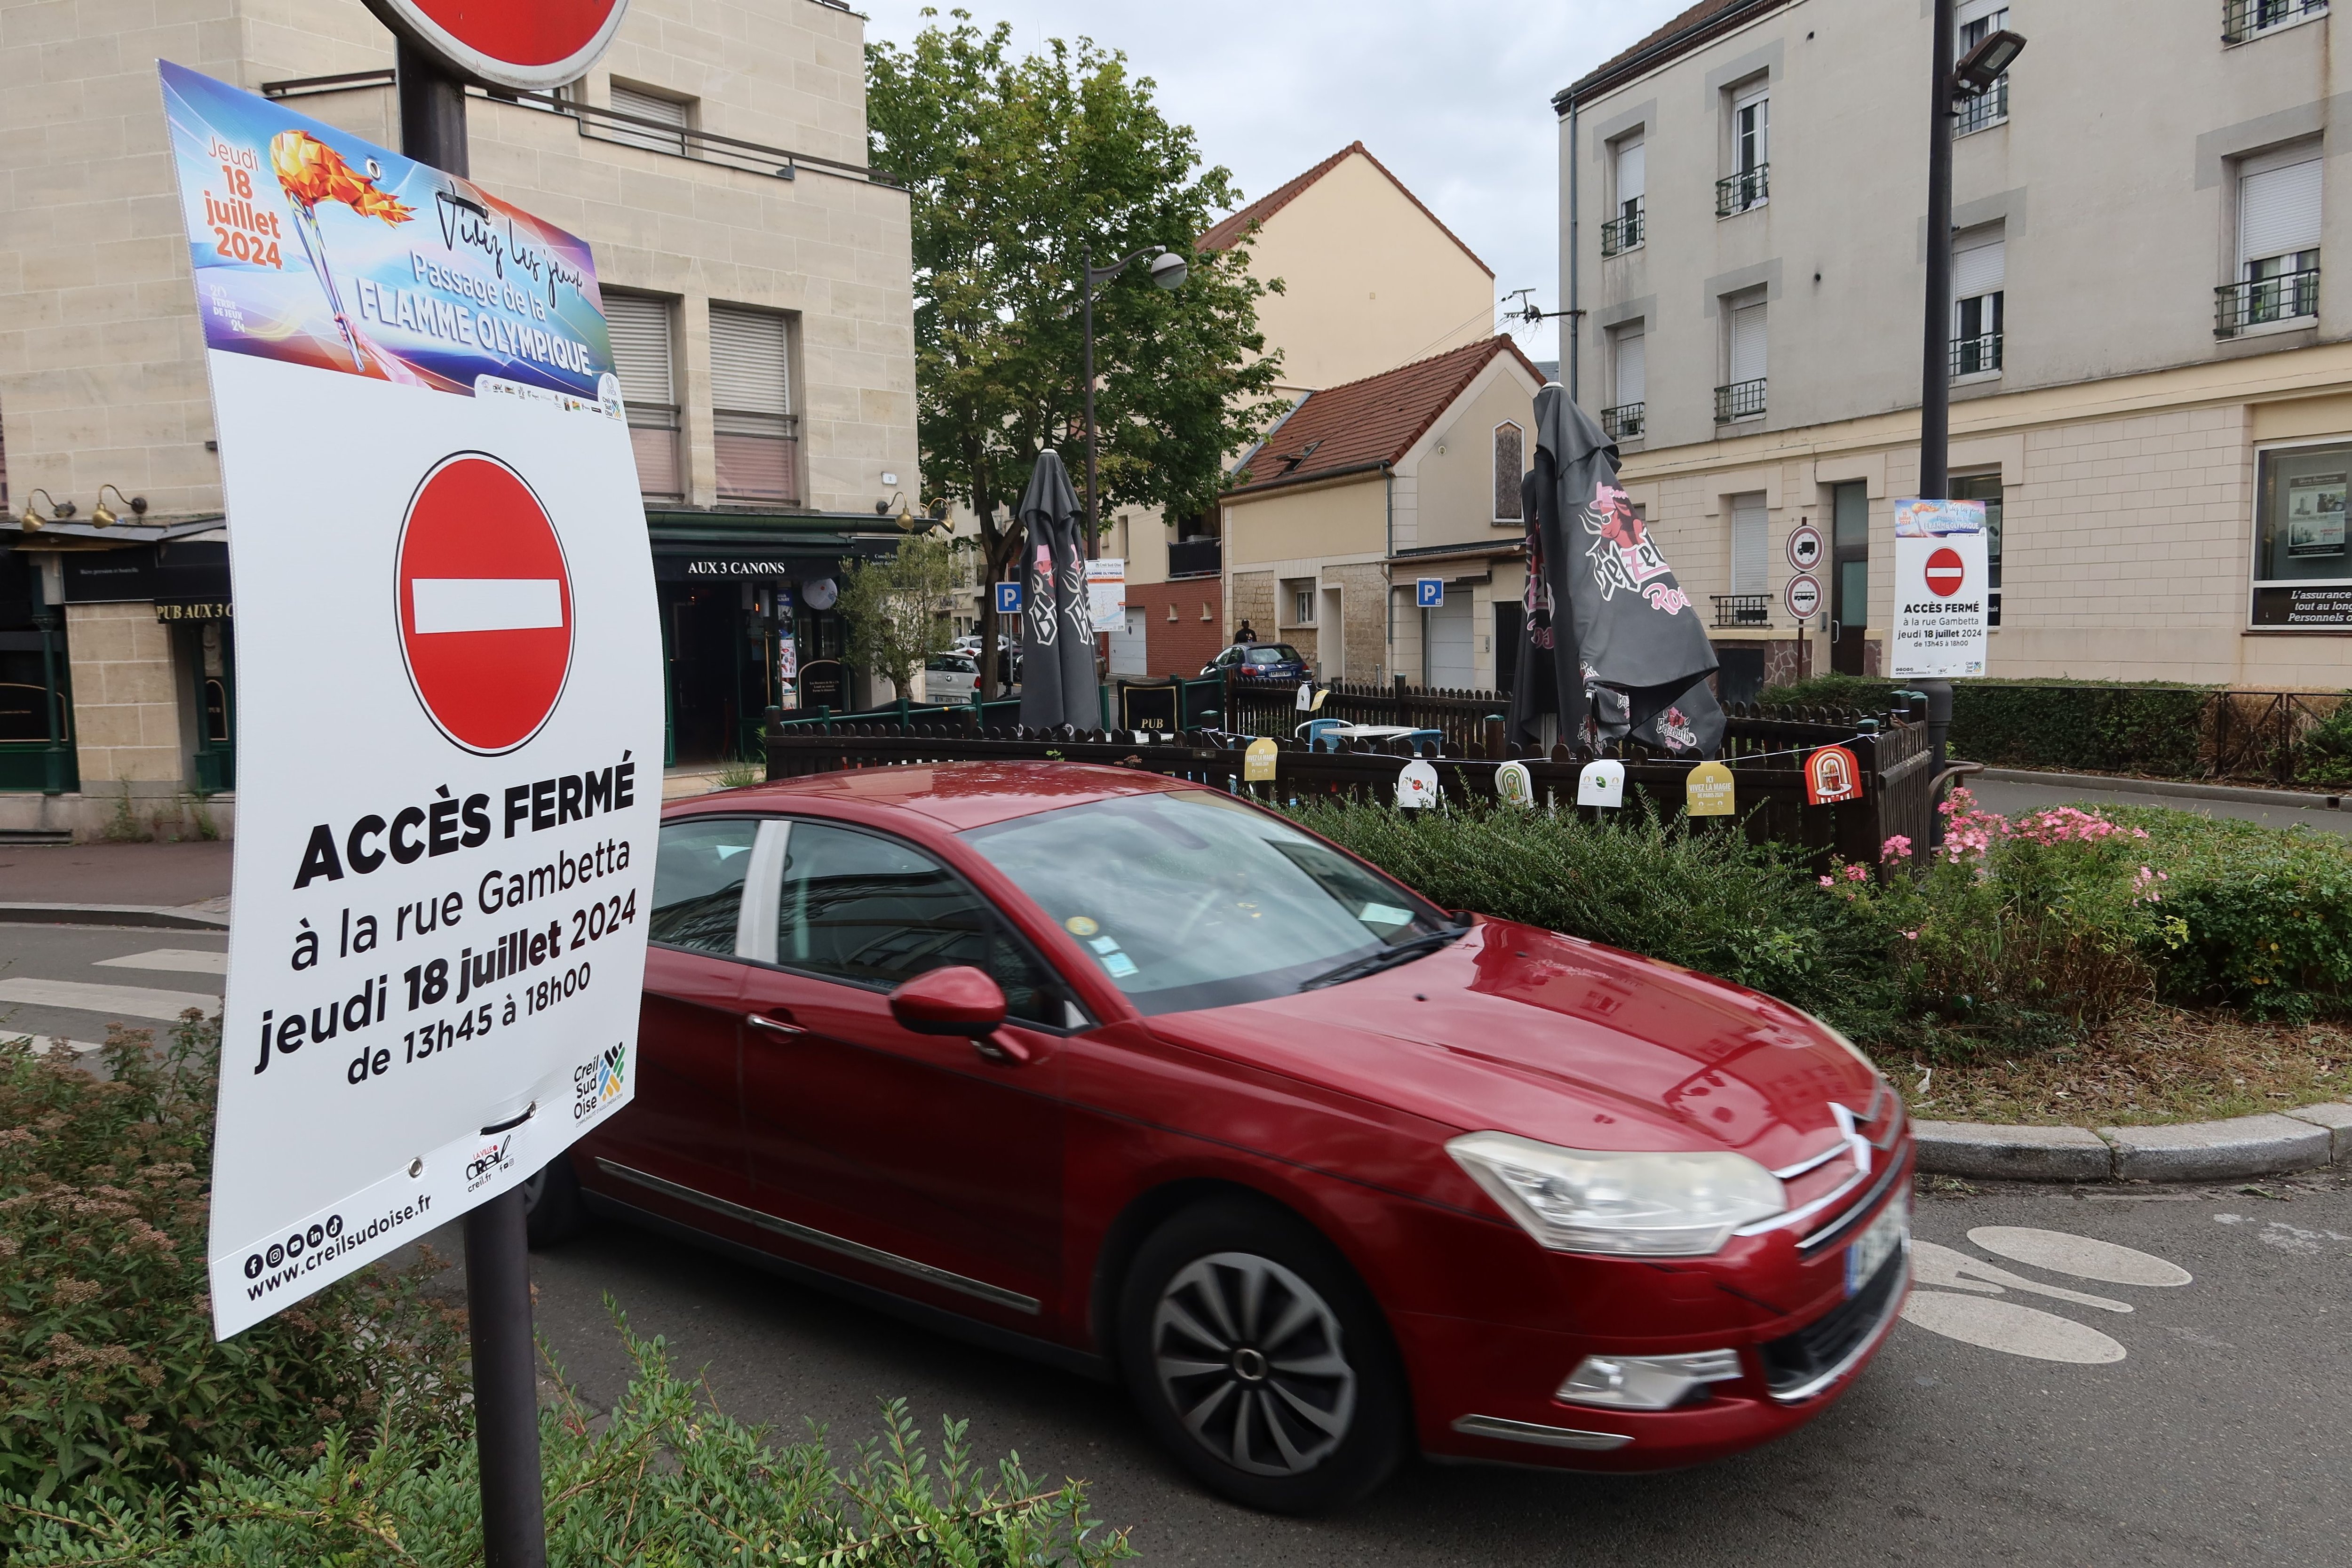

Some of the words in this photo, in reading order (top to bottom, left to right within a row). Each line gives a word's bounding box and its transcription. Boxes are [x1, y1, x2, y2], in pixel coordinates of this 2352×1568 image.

[208, 136, 259, 172] Jeudi
[222, 165, 253, 199] 18
[204, 190, 281, 239] juillet
[214, 227, 283, 270] 2024
[411, 249, 499, 307] Passage
[503, 281, 525, 310] de
[528, 289, 546, 322] la
[212, 297, 237, 310] TERRE
[213, 306, 224, 317] DE
[224, 309, 244, 321] JEUX
[231, 319, 245, 333] 24
[357, 278, 472, 344] FLAMME
[476, 312, 593, 377] OLYMPIQUE
[688, 562, 718, 573] AUX
[720, 562, 727, 573] 3
[731, 562, 785, 574] CANONS
[1004, 589, 1016, 606] P
[1424, 585, 1436, 601] P
[2290, 590, 2352, 599] L'assurance
[156, 605, 182, 620] PUB
[183, 604, 213, 618] AUX
[215, 603, 223, 617] 3
[1904, 602, 1942, 613] ACCÈS
[1945, 601, 1979, 613] FERMÉ
[2288, 613, 2344, 621] Personnels
[1898, 630, 1921, 640] jeudi
[1935, 629, 1959, 639] juillet
[1141, 718, 1163, 729] PUB
[293, 784, 492, 890] ACCÈS
[504, 749, 636, 839] FERMÉ
[291, 917, 318, 971] à
[340, 908, 377, 958] la
[397, 892, 463, 942] rue
[478, 838, 630, 915] Gambetta
[254, 973, 387, 1075] jeudi
[404, 957, 449, 1012] 18
[456, 920, 562, 1003] juillet
[570, 888, 637, 951] 2024
[347, 1046, 390, 1085] de
[403, 1003, 493, 1065] 13h45
[502, 995, 517, 1027] à
[526, 961, 591, 1017] 18h00
[574, 1054, 600, 1082] Creil
[576, 1073, 597, 1098] Sud
[574, 1096, 597, 1119] Oise
[480, 1146, 493, 1156] VILLE
[468, 1173, 492, 1193] creil.fr
[246, 1194, 432, 1302] www.creilsudoise.fr
